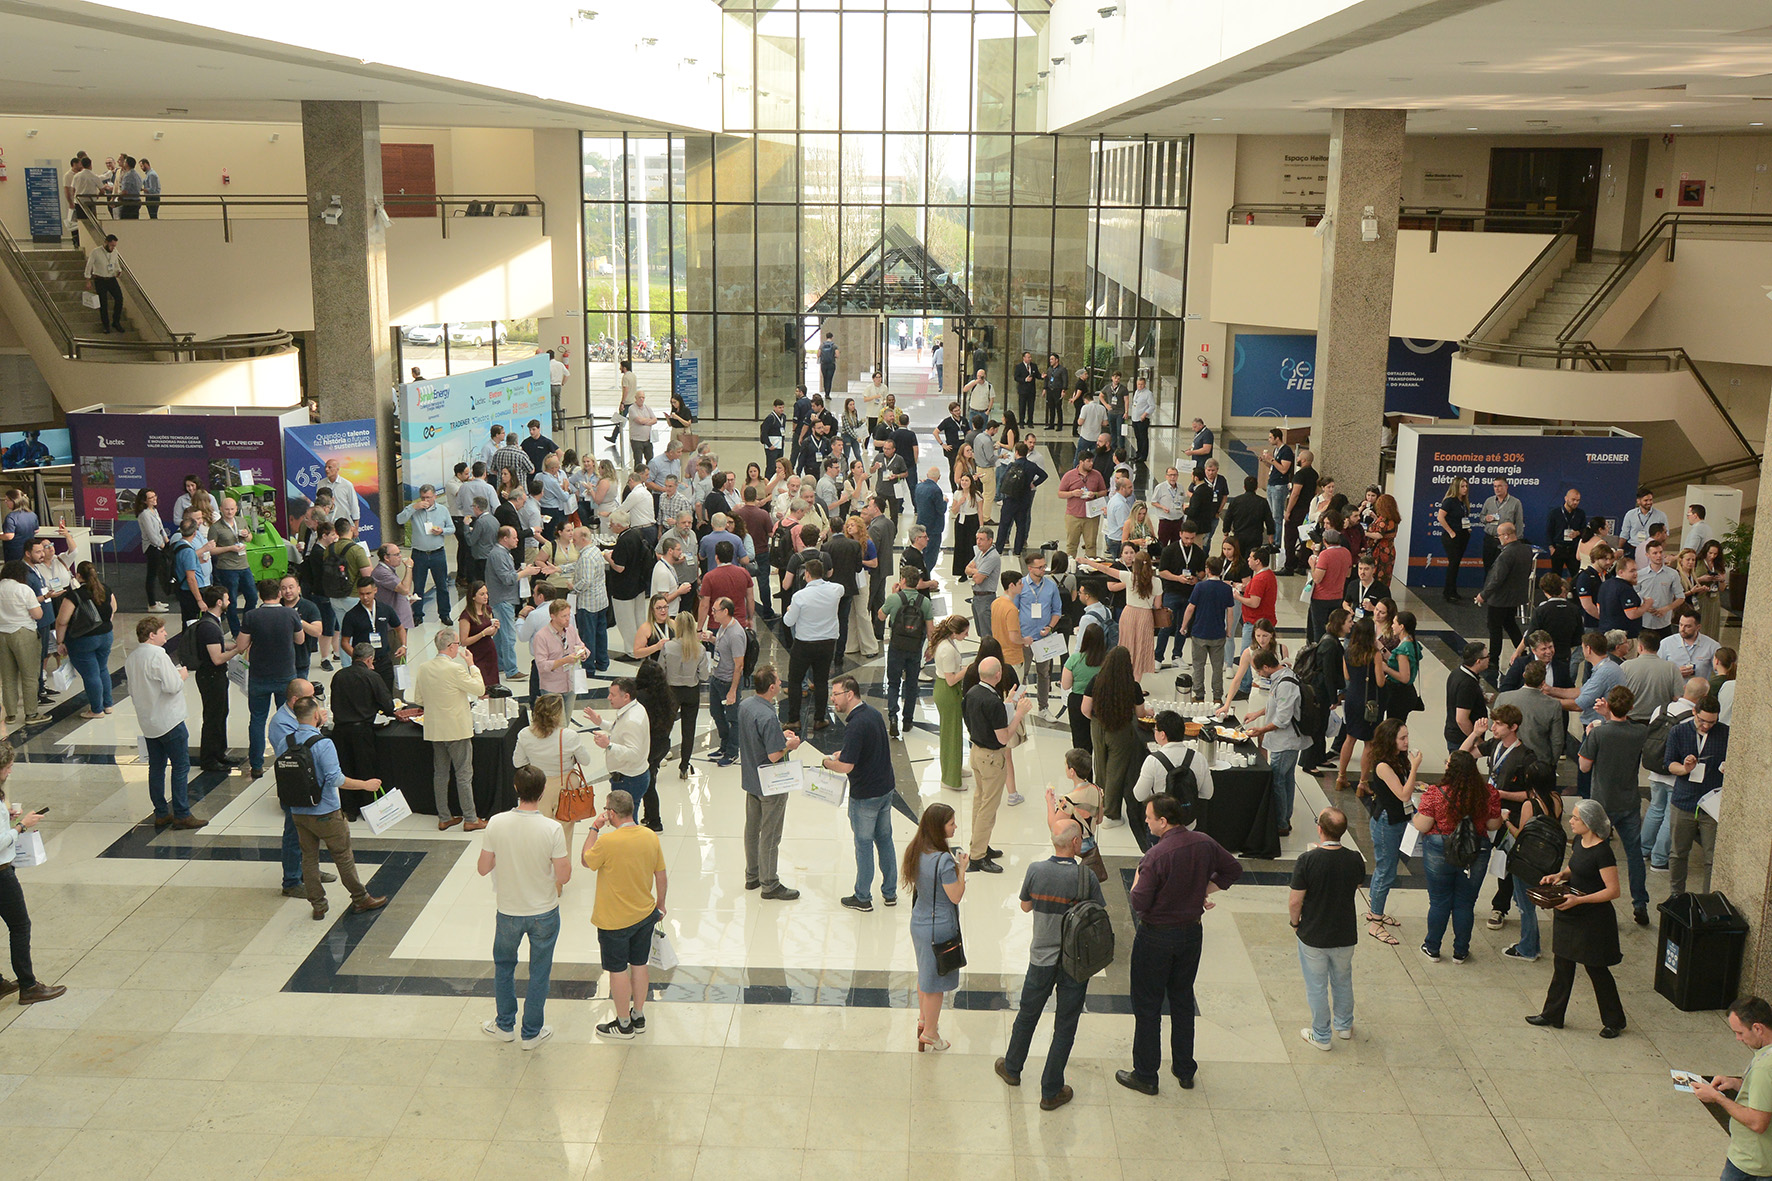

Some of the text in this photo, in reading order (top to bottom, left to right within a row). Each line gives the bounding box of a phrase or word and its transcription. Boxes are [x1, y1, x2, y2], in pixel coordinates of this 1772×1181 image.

[1286, 378, 1315, 390] FIE
[434, 388, 450, 400] Energy
[316, 432, 342, 441] Quando
[347, 429, 370, 437] talento
[323, 436, 347, 446] história
[334, 440, 371, 450] sustentável
[1434, 452, 1525, 463] Economize até 30%
[1585, 453, 1630, 463] TRADENER
[1432, 464, 1522, 476] na conta de energia
[295, 465, 323, 488] 65
[1432, 474, 1454, 485] elétr
[1468, 475, 1480, 485] da
[1506, 477, 1540, 487] mpresa
[358, 524, 374, 533] actec
